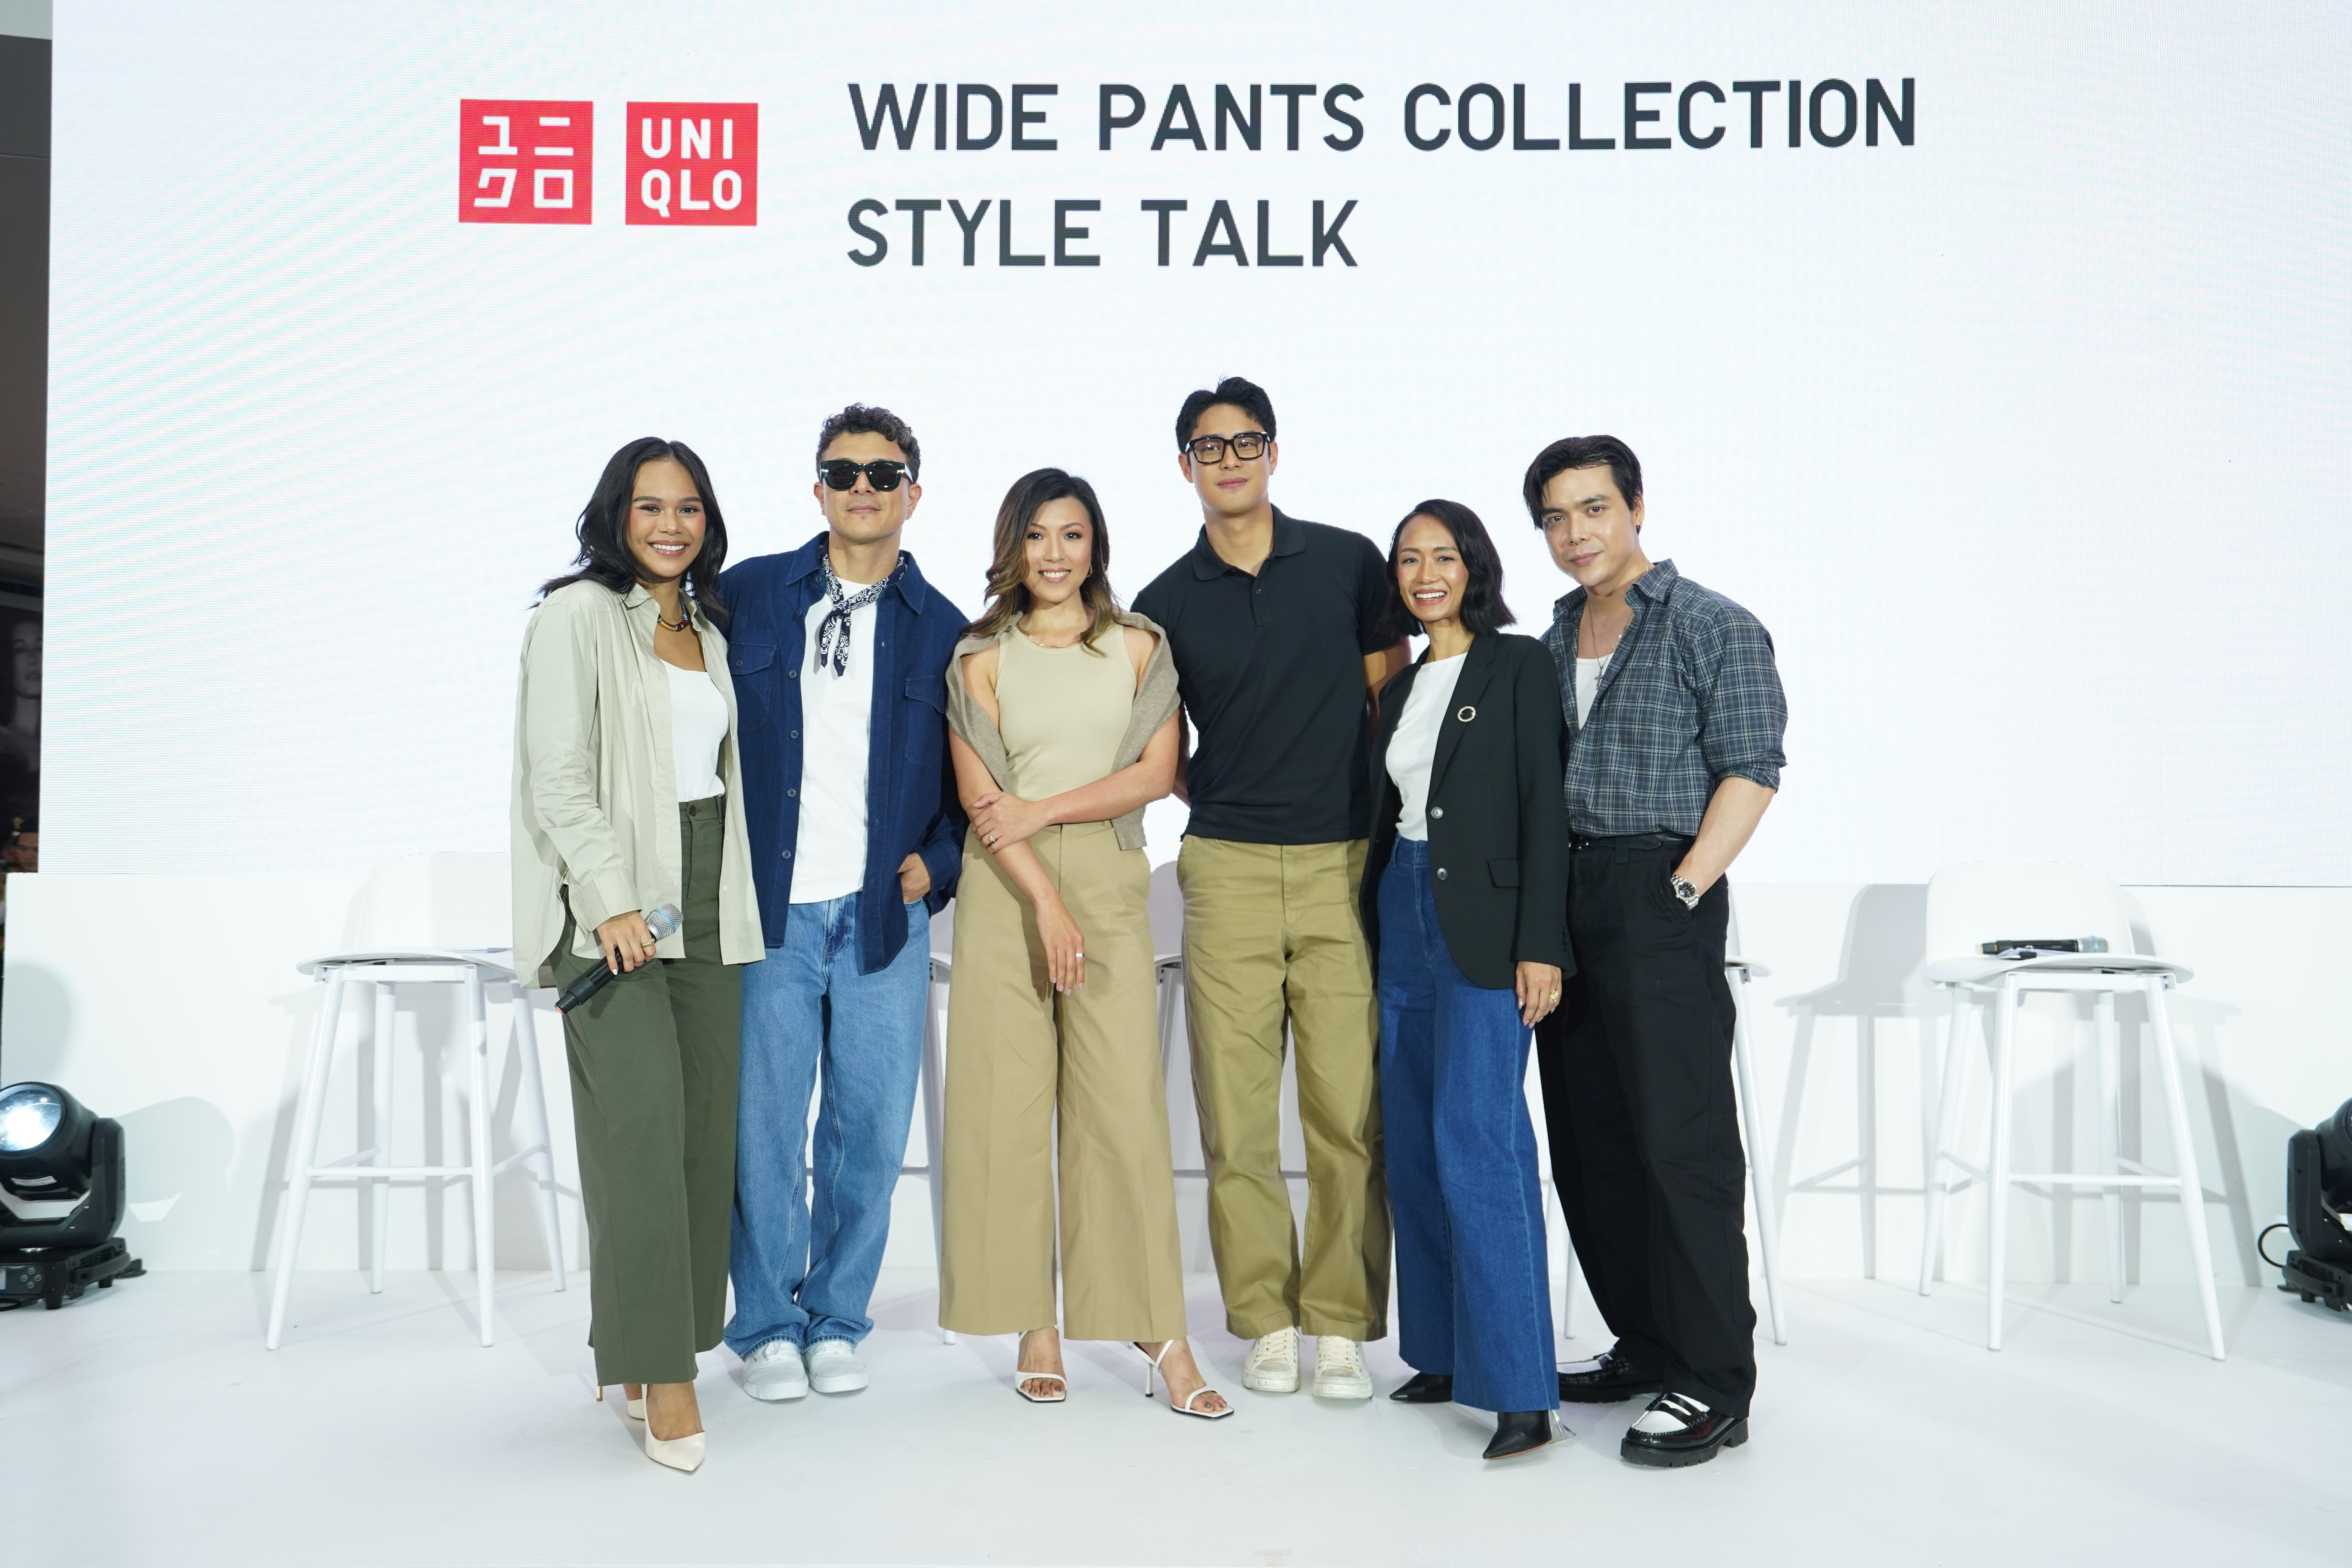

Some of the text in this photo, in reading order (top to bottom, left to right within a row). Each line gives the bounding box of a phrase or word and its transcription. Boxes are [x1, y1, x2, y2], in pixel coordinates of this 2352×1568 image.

[478, 116, 573, 156] ユニ
[848, 78, 1915, 151] WIDE PANTS COLLECTION
[642, 118, 733, 160] UNI
[474, 168, 573, 209] クロ
[641, 169, 742, 218] QLO
[848, 199, 1358, 267] STYLE TALK
